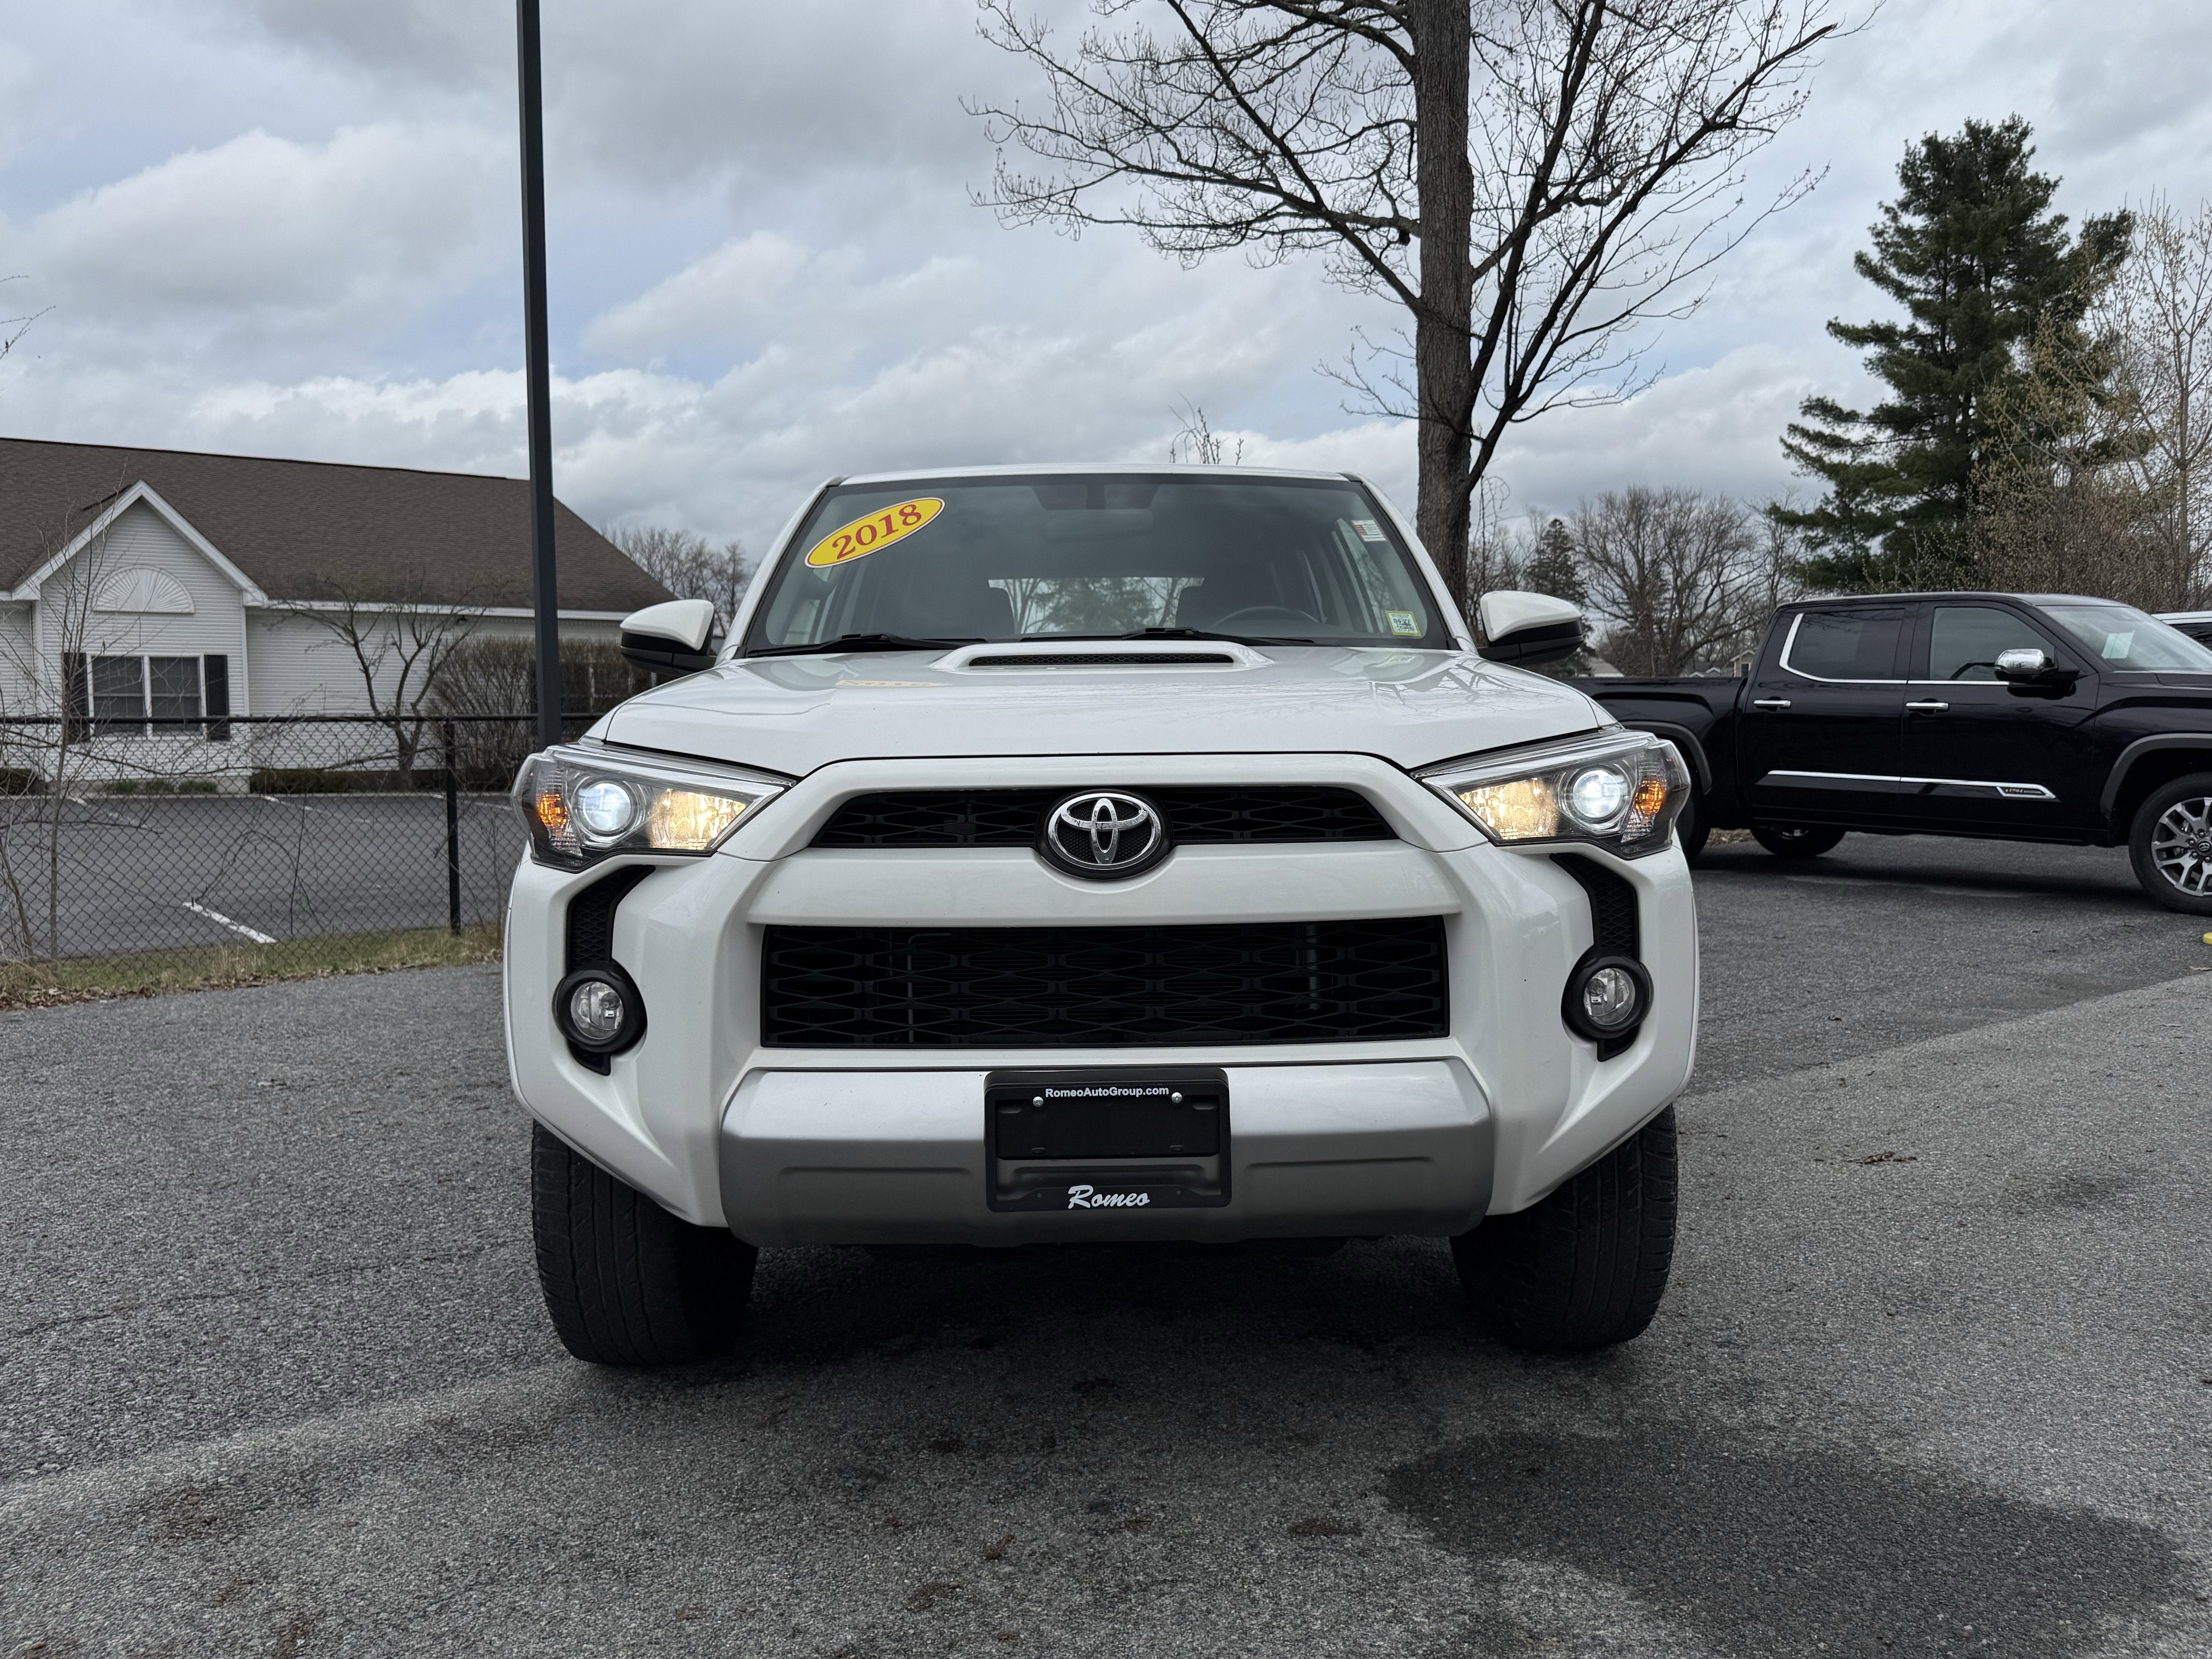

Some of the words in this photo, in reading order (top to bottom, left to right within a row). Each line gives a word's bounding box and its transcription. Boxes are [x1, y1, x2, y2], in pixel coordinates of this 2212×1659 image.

[832, 504, 922, 560] 2018
[1045, 1086, 1169, 1097] RomeoAutoGroup.com
[1068, 1185, 1150, 1209] Romeo
